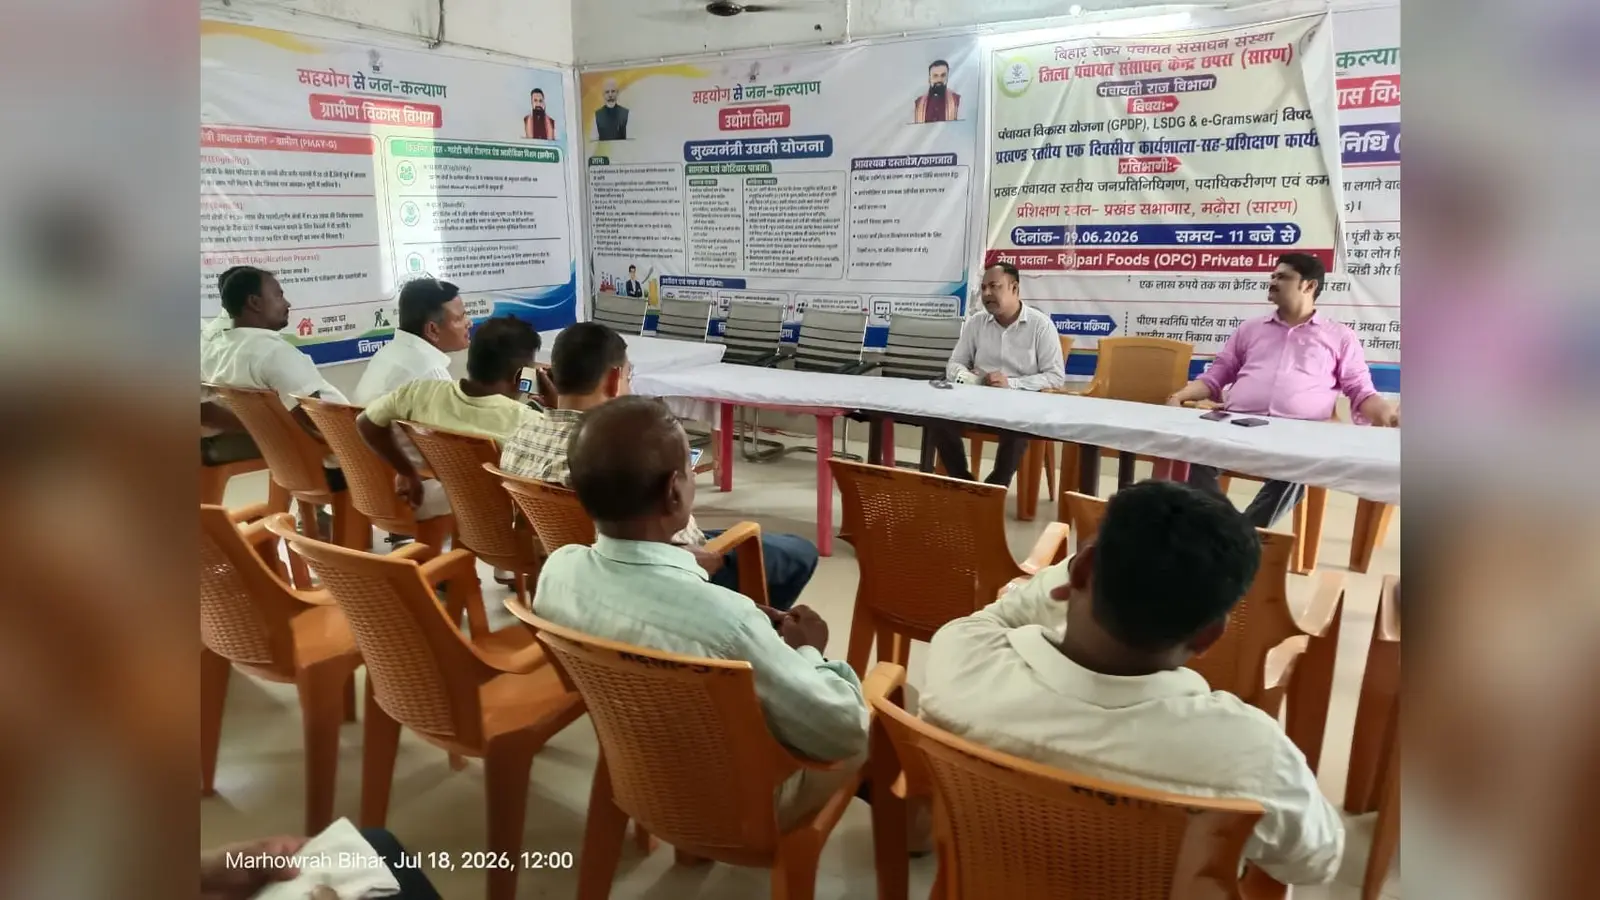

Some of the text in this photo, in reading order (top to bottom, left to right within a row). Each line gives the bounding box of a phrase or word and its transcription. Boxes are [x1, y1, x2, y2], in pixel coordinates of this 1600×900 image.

[1054, 46, 1088, 60] बिहार
[1093, 44, 1120, 57] राज्य
[1235, 31, 1275, 47] संस्था
[1038, 66, 1069, 83] जिला
[1075, 60, 1115, 78] पंचायत
[1201, 52, 1234, 69] छपरा
[1241, 43, 1293, 69] (सारण)
[1335, 47, 1400, 68] कल्या
[297, 68, 448, 98] सहयोग से जन-कल्याण
[692, 80, 821, 104] सहयोग से जन-कल्याण
[1099, 78, 1213, 96] पंचायती राज विभाग
[319, 99, 435, 125] ग्रामीण विकास विभाग
[725, 109, 784, 128] उद्योग विभाग
[998, 127, 1030, 140] पंचायत
[1033, 123, 1066, 137] विकास
[1069, 119, 1103, 133] योजना
[1154, 115, 1186, 129] LSDG
[1189, 115, 1198, 127] &
[1201, 110, 1278, 127] e-Gramswarj
[690, 138, 824, 161] मुख्यमंत्री उद्यमी योजना
[1066, 143, 1085, 157] एक
[1089, 138, 1134, 156] दिवसीय
[1340, 131, 1390, 153] निधि
[1060, 178, 1093, 193] स्तरीय
[1282, 172, 1301, 189] एवं
[1354, 177, 1382, 191] लगाने
[1017, 202, 1060, 218] प्रशिक्षण
[1104, 200, 1136, 217] प्रखंड
[1246, 198, 1298, 216] (सारण)
[1229, 230, 1243, 243] 11
[1248, 225, 1276, 243] बजे
[1280, 225, 1296, 243] से
[1351, 230, 1370, 245] पूंजी
[1373, 229, 1384, 241] के
[1107, 253, 1150, 266] Foods
[1154, 254, 1196, 269] (OPC)
[1201, 254, 1253, 267] Private
[1354, 248, 1368, 258] का
[1371, 246, 1390, 258] लोन
[1373, 263, 1391, 275] और
[1139, 279, 1153, 289] एक
[1155, 280, 1176, 289] लाख
[1178, 279, 1198, 290] रुपये
[1200, 281, 1216, 290] तक
[1218, 281, 1231, 290] का
[1233, 279, 1257, 291] क्रेडिट
[1055, 319, 1110, 331] आवेदन प्रक्रिया
[1137, 315, 1157, 326] पीएम
[1160, 315, 1188, 326] स्वनिधि
[1191, 315, 1213, 327] पोर्टल
[1216, 318, 1226, 327] या
[1358, 321, 1386, 332] अथवा
[1185, 331, 1212, 342] निकाय
[1367, 338, 1400, 350] ऑनला
